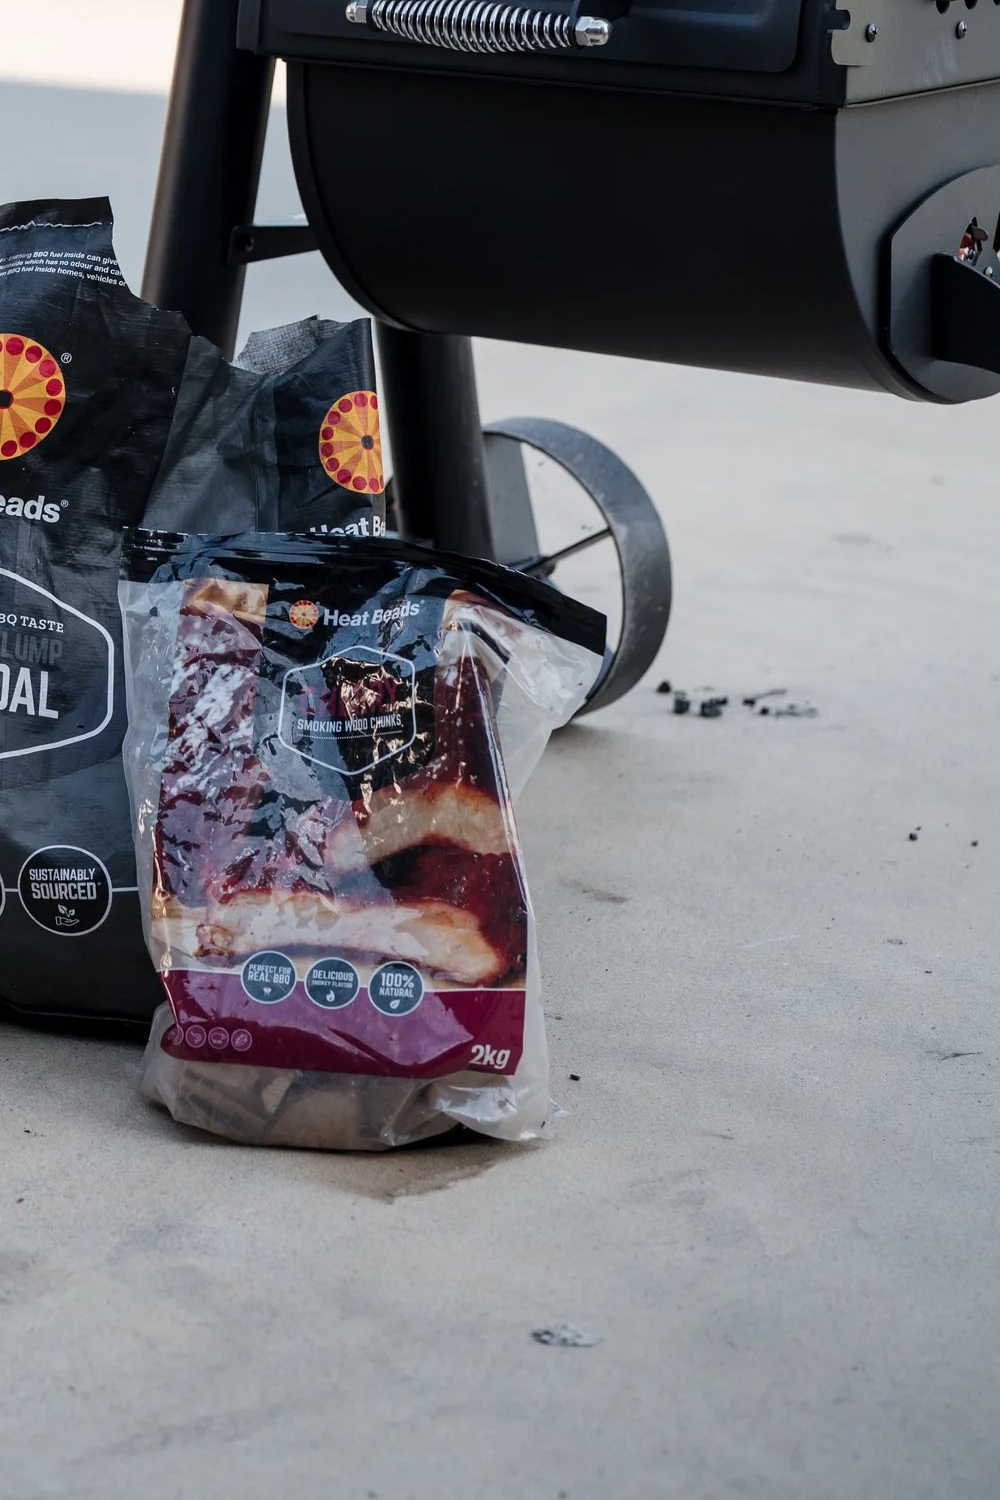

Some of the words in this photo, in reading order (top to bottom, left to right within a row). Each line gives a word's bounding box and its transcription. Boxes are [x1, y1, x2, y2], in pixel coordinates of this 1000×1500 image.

[64, 251, 85, 259] inside
[86, 254, 101, 262] can
[70, 260, 93, 270] odour
[94, 265, 109, 273] and
[21, 265, 34, 273] fuel
[35, 266, 56, 274] inside
[57, 266, 85, 279] homes,
[86, 272, 117, 285] vehicles
[20, 615, 64, 633] TASTE
[323, 608, 368, 627] Heat
[1, 630, 64, 665] LUMP
[297, 718, 342, 733] SMOKING
[345, 717, 368, 732] WOOD
[370, 713, 402, 729] CHUNKS
[29, 867, 96, 882] SUSTAINABLY
[31, 882, 97, 901] SOURCED
[248, 963, 277, 974] PERFECT
[278, 966, 292, 975] FOR
[312, 969, 354, 982] DELICIOUS
[247, 970, 270, 983] REAL
[273, 973, 291, 986] BBQ
[381, 973, 415, 989] 100%
[379, 987, 414, 998] NATURAL
[468, 1044, 510, 1070] 2kg
